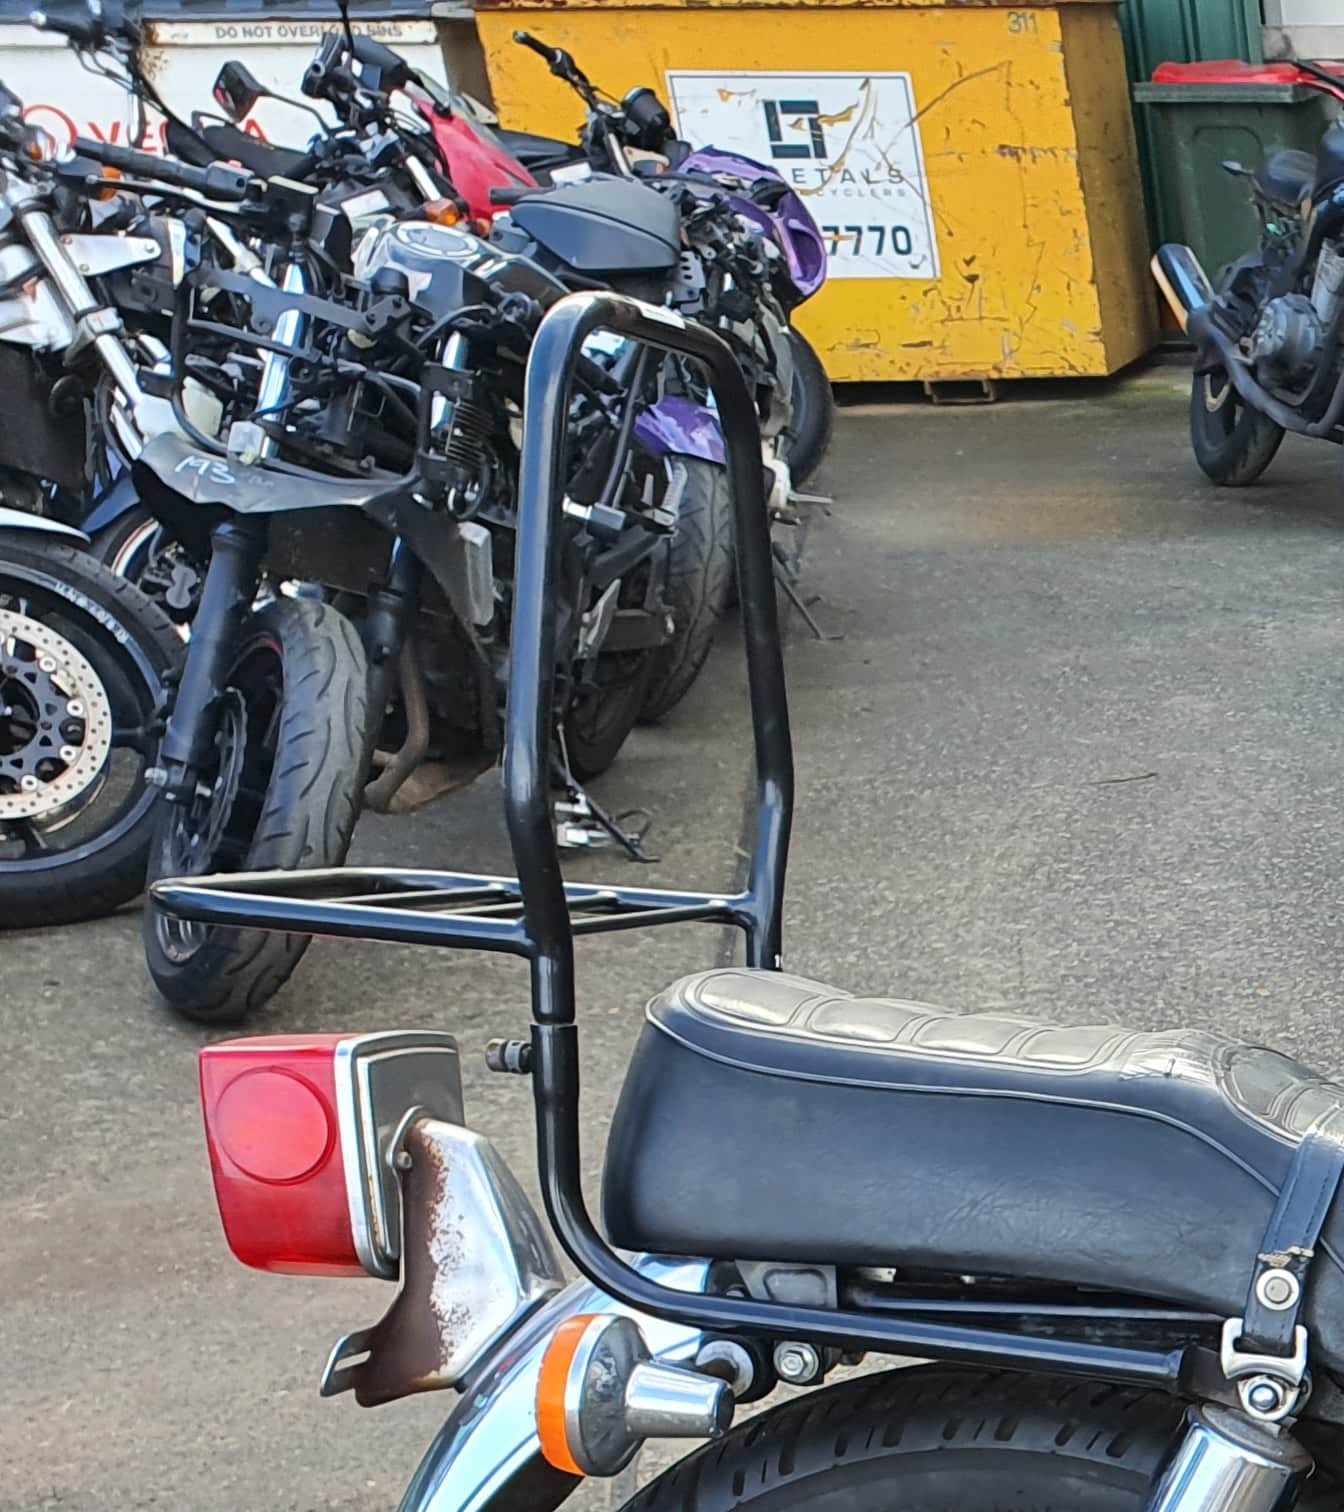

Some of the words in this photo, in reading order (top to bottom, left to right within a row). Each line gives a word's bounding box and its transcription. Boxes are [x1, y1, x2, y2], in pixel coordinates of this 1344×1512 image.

[1007, 11, 1039, 34] 311
[215, 27, 238, 40] DO
[243, 25, 272, 39] NOT
[792, 167, 904, 185] ETALS
